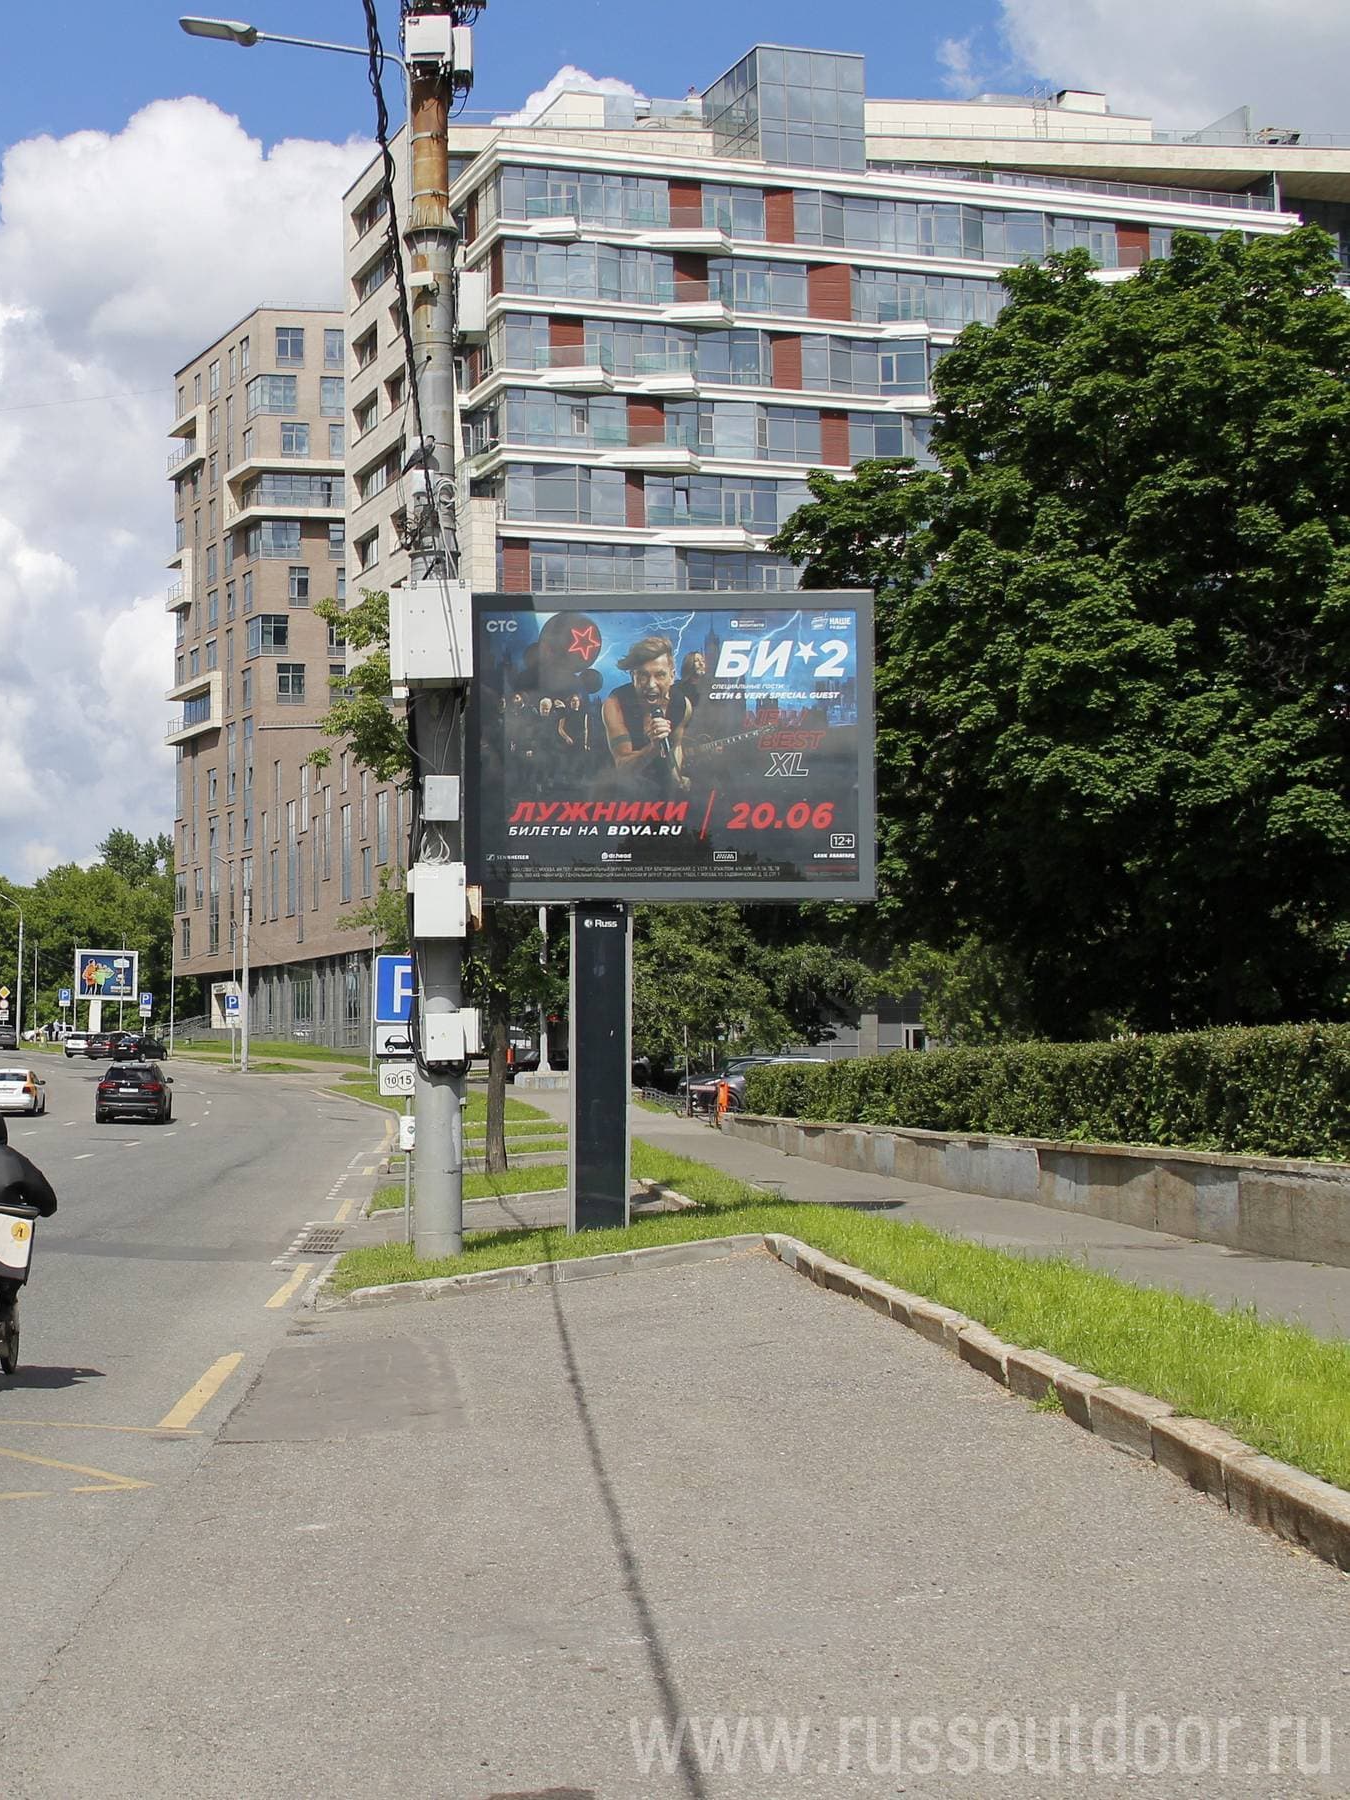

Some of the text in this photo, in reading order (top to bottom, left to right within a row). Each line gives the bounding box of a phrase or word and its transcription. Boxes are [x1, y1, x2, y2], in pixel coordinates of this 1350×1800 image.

[485, 619, 518, 633] СТС
[758, 730, 827, 751] BEST
[764, 752, 810, 777] XL
[508, 801, 689, 823] ЛУЖНИКИ
[726, 801, 835, 830] 20.06
[508, 825, 683, 836] БИЛЕТЫ НА BDVA.RU
[832, 836, 853, 846] 12+
[594, 919, 618, 928] Russ
[387, 1075, 412, 1085] 10 15
